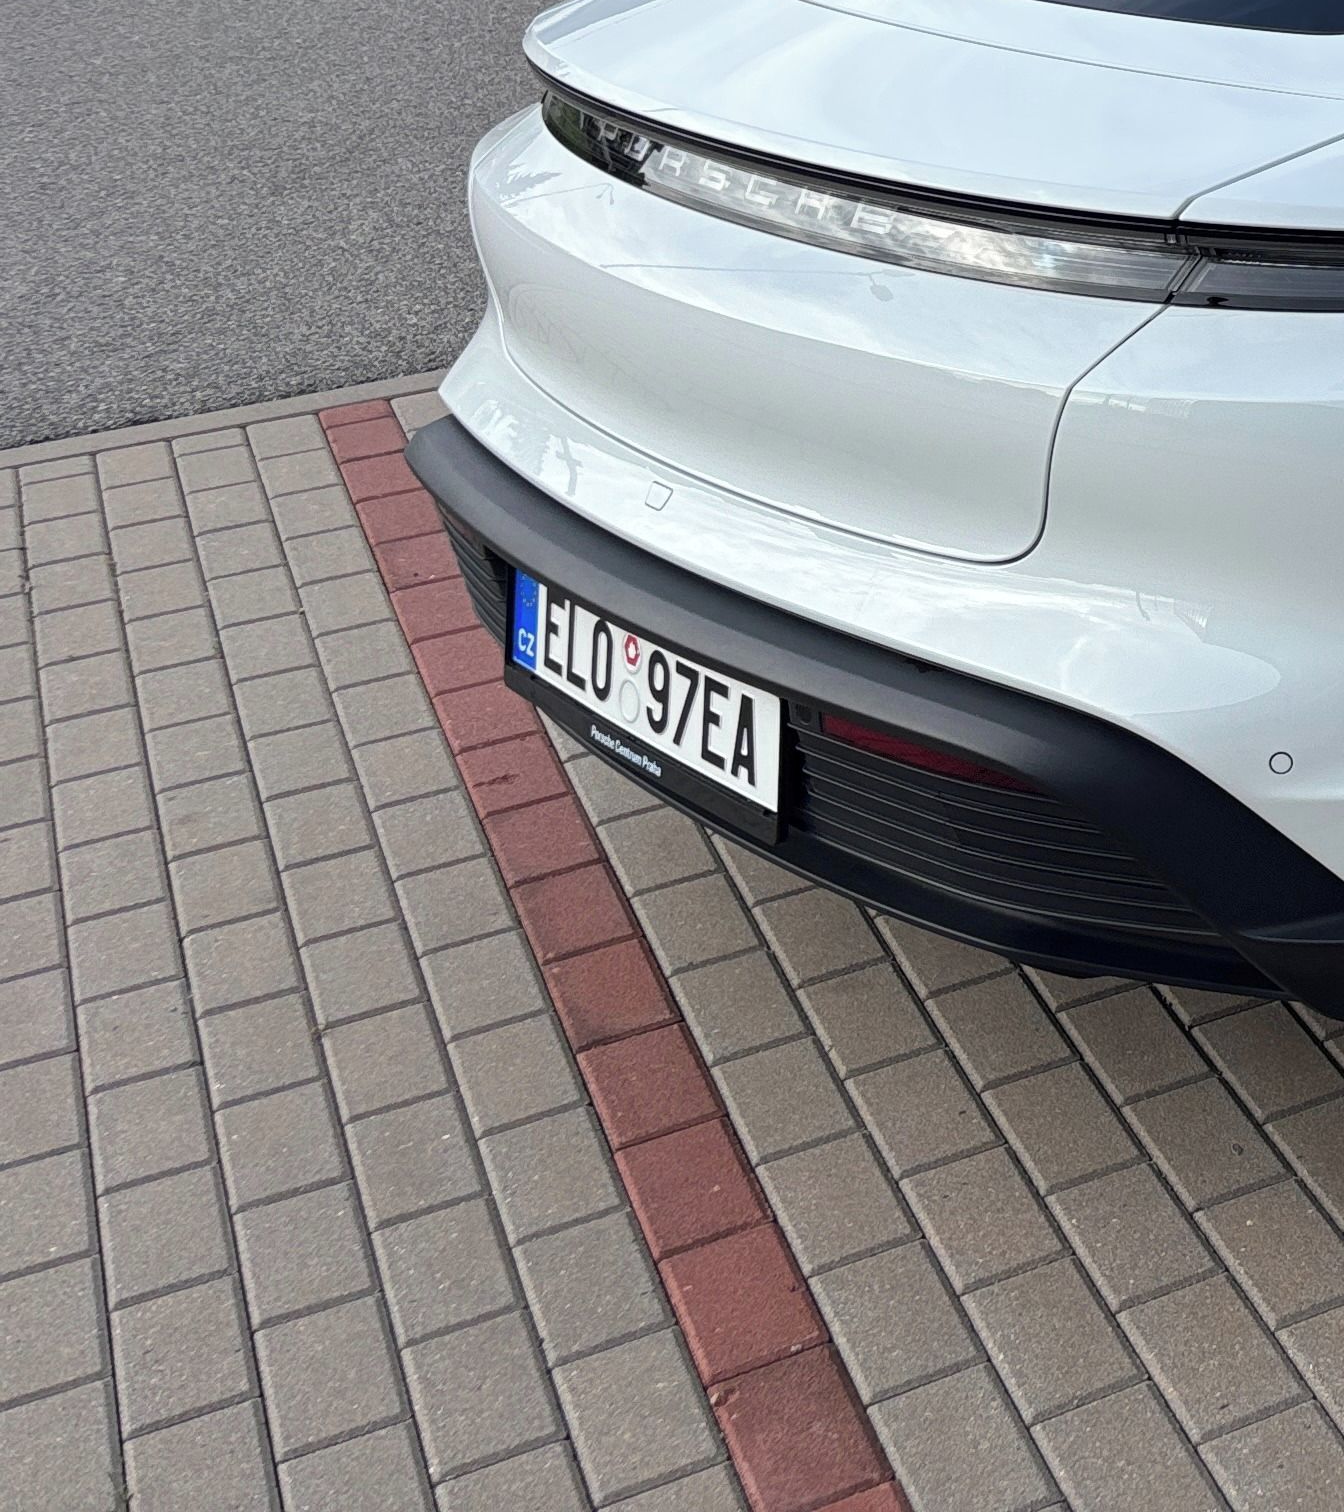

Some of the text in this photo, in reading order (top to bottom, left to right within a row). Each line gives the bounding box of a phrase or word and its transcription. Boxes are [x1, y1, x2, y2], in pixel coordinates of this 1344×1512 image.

[600, 118, 896, 235] PORSCHE
[518, 627, 535, 657] CZ
[591, 724, 662, 778] Porsche Centrum Praha
[646, 649, 757, 787] 97EA
